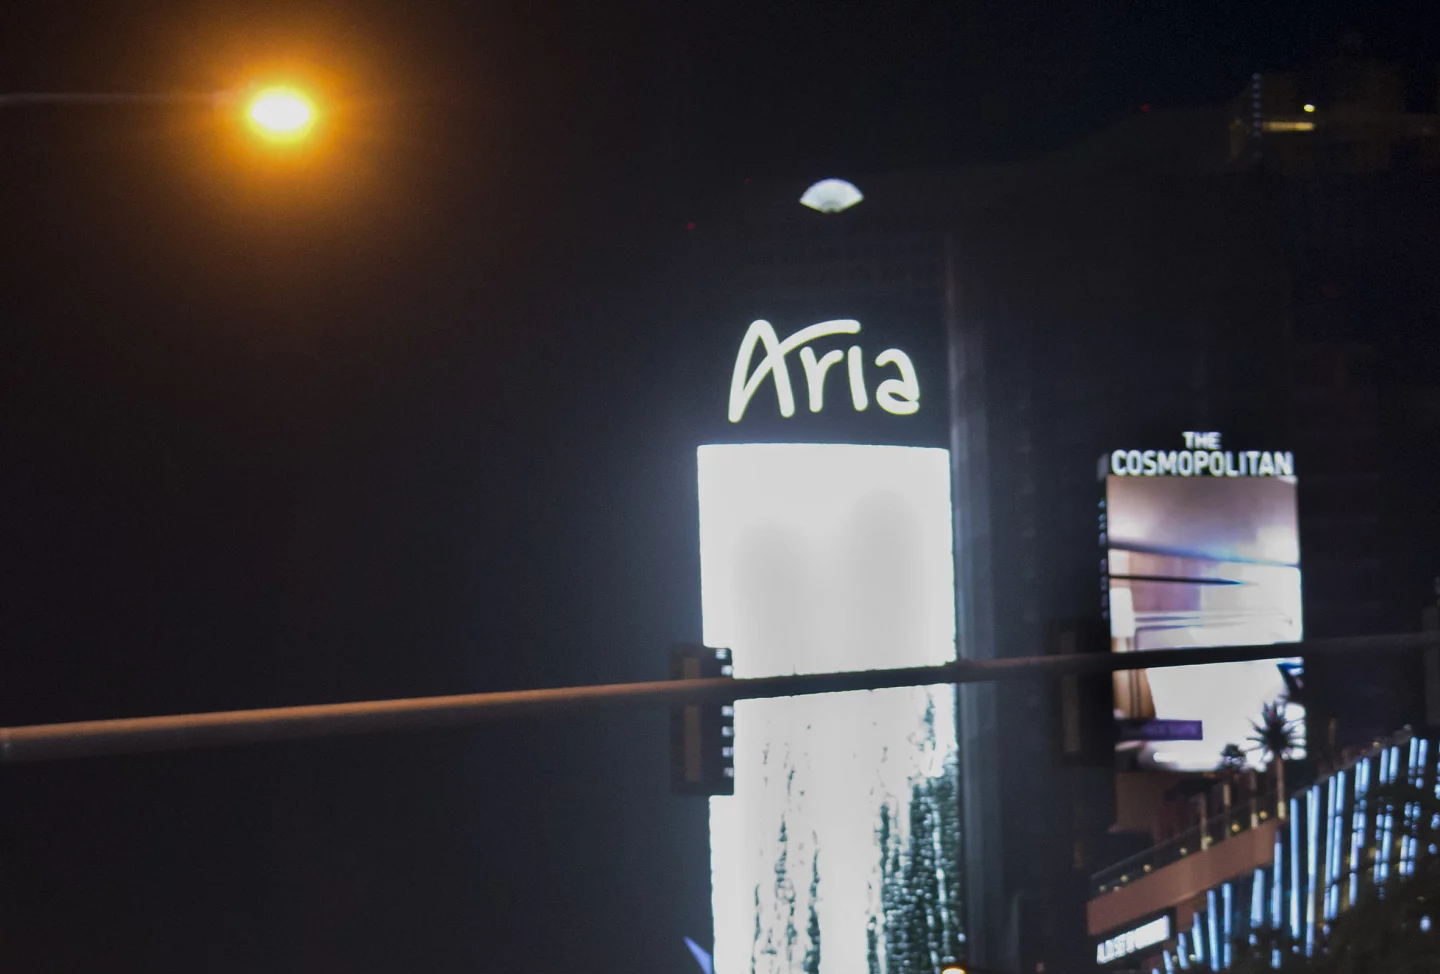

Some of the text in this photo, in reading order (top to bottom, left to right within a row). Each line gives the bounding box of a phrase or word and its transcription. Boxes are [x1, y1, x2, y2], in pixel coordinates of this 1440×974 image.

[728, 319, 920, 423] Aria
[1181, 431, 1222, 450] THE
[1110, 449, 1294, 476] COSMOPOLITAN
